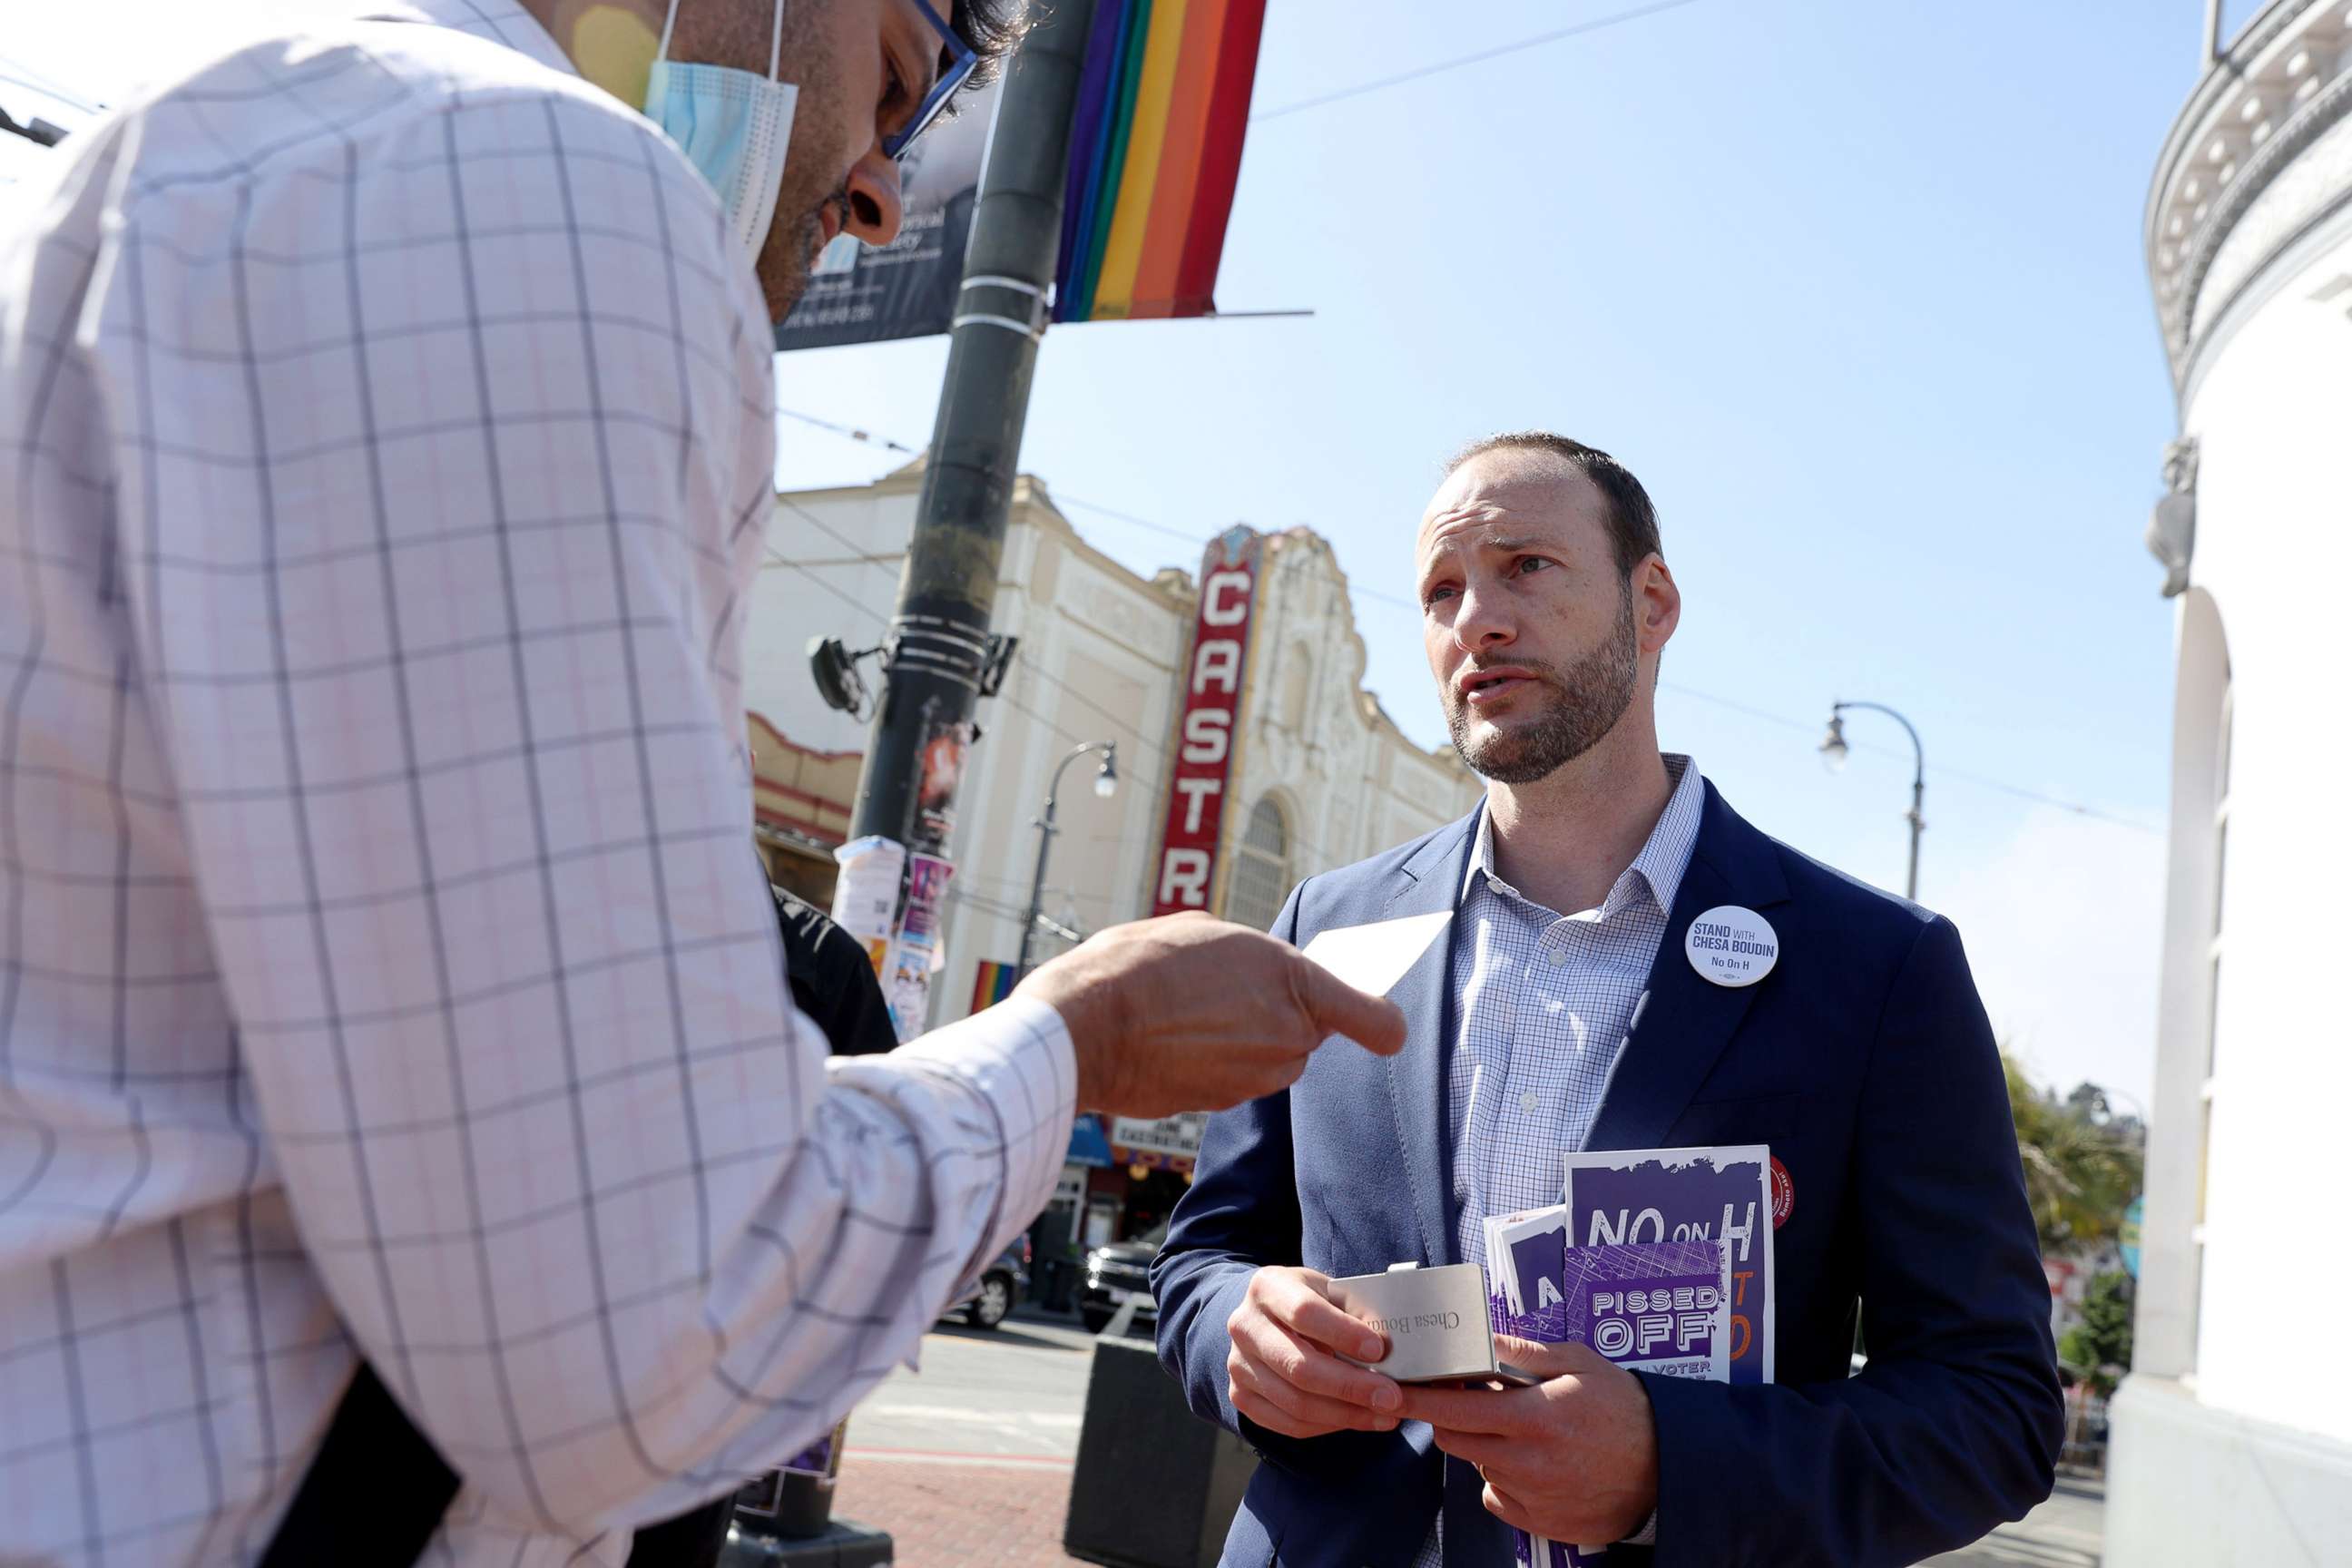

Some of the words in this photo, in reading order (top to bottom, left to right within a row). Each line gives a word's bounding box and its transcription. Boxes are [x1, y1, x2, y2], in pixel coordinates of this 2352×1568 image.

[1160, 572, 1251, 906] CASTR
[1694, 923, 1730, 937] STAND
[1733, 929, 1755, 941] WITH
[1692, 936, 1730, 951] CHESA
[1731, 940, 1775, 957] BOUDIN
[1711, 956, 1724, 967] No
[1727, 958, 1740, 969] On
[1742, 961, 1749, 970] H
[1589, 1208, 1664, 1247] NO
[1672, 1222, 1710, 1242] ON
[1720, 1201, 1756, 1262] H
[1592, 1286, 1718, 1316] PISSED
[1416, 1311, 1459, 1329] Chesa
[1594, 1311, 1711, 1357] OFF
[1653, 1361, 1711, 1376] VOTER
